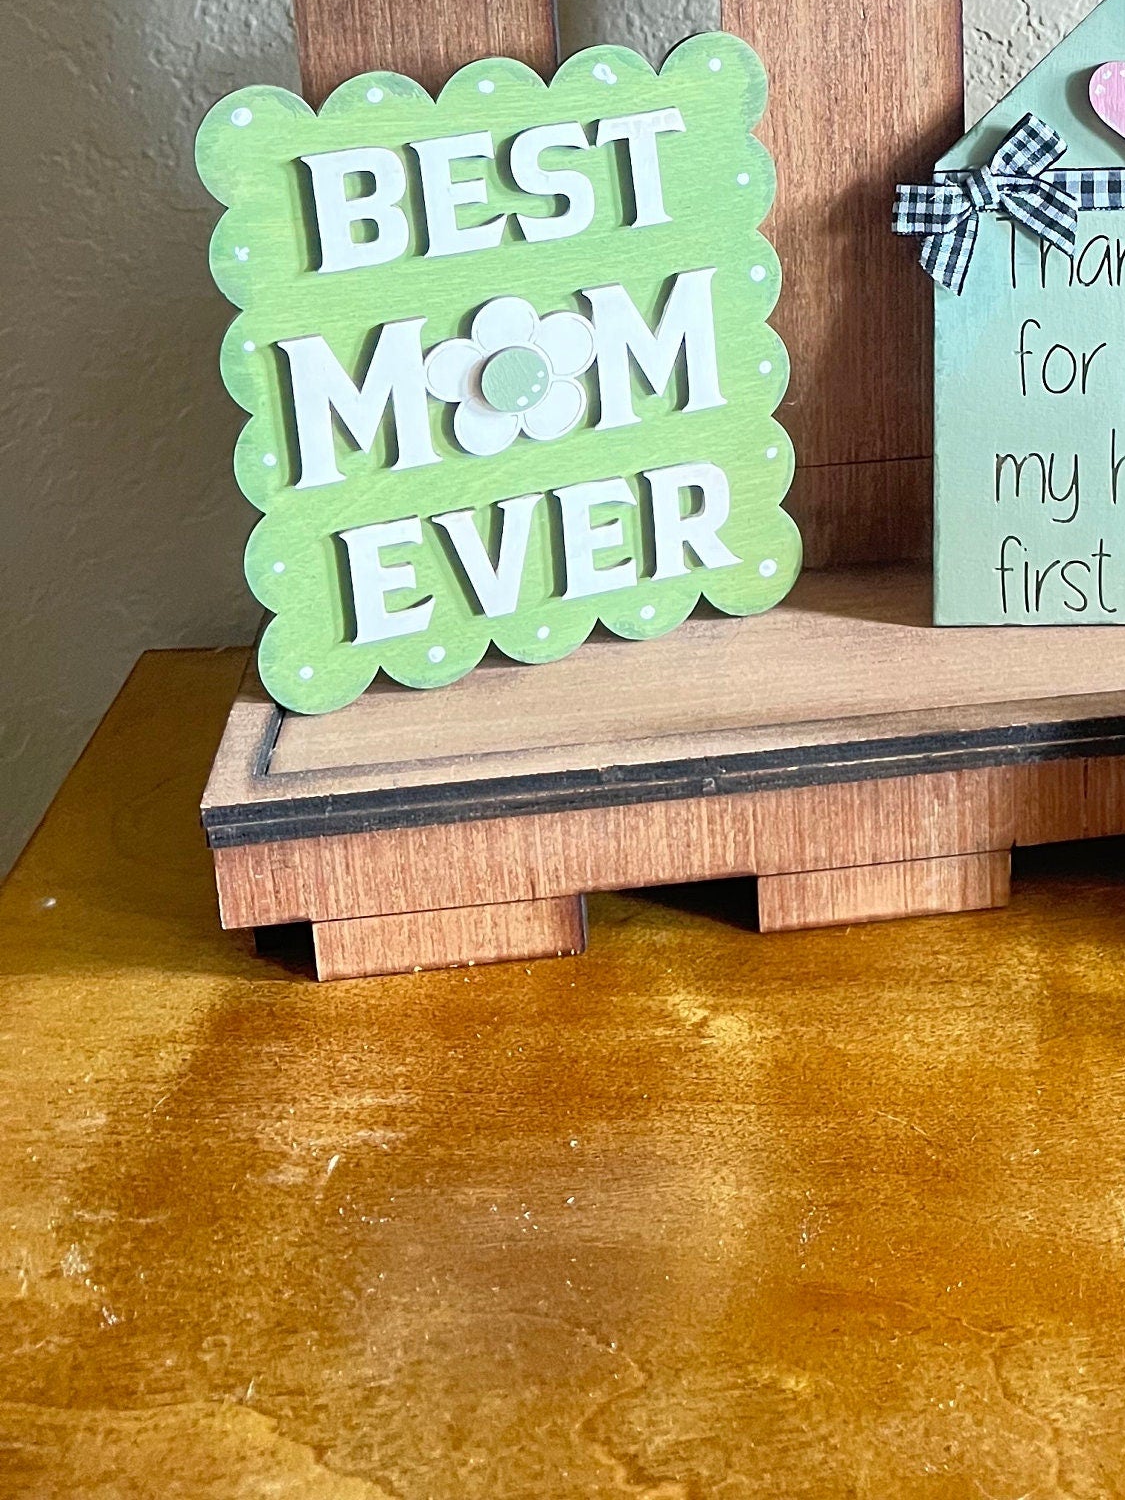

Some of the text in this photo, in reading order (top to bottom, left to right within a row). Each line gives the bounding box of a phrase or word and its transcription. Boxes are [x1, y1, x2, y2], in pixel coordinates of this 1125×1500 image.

[300, 107, 687, 274] BEST
[1013, 319, 1107, 396] for
[995, 453, 1079, 523] my
[339, 462, 743, 646] EVER
[994, 536, 1117, 613] first
